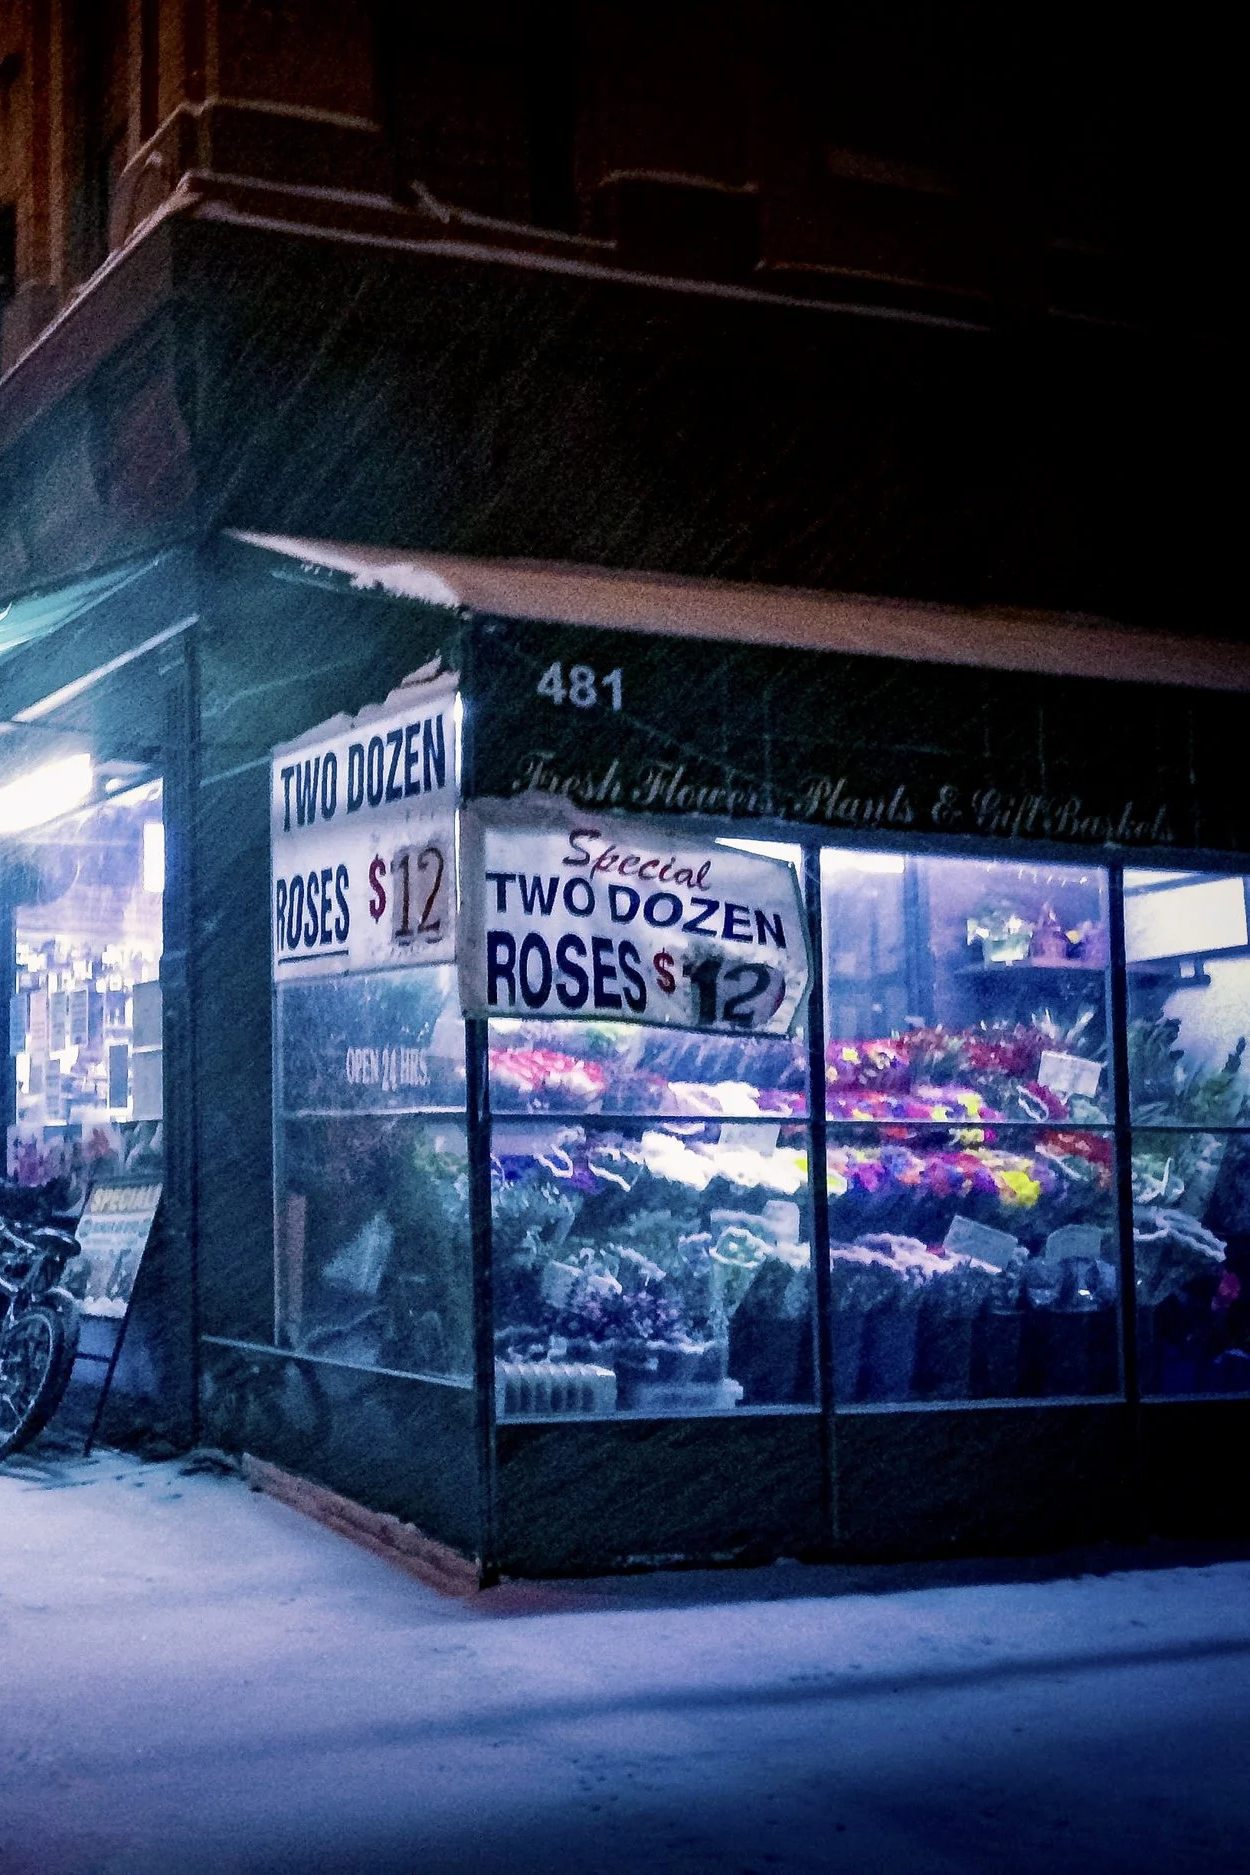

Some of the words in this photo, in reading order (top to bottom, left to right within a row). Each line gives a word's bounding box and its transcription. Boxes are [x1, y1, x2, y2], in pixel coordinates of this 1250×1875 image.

[537, 661, 623, 712] 481
[281, 751, 338, 832] TWO
[347, 714, 446, 815] DOZEN
[512, 751, 621, 802] Fresh
[794, 776, 914, 828] Plants
[931, 784, 963, 826] &
[562, 828, 713, 892] Special
[276, 863, 350, 952] ROSES
[485, 871, 596, 918] TWO
[608, 883, 787, 950] DOZEN
[486, 930, 647, 1014] ROSES
[346, 1046, 379, 1086] OPEN
